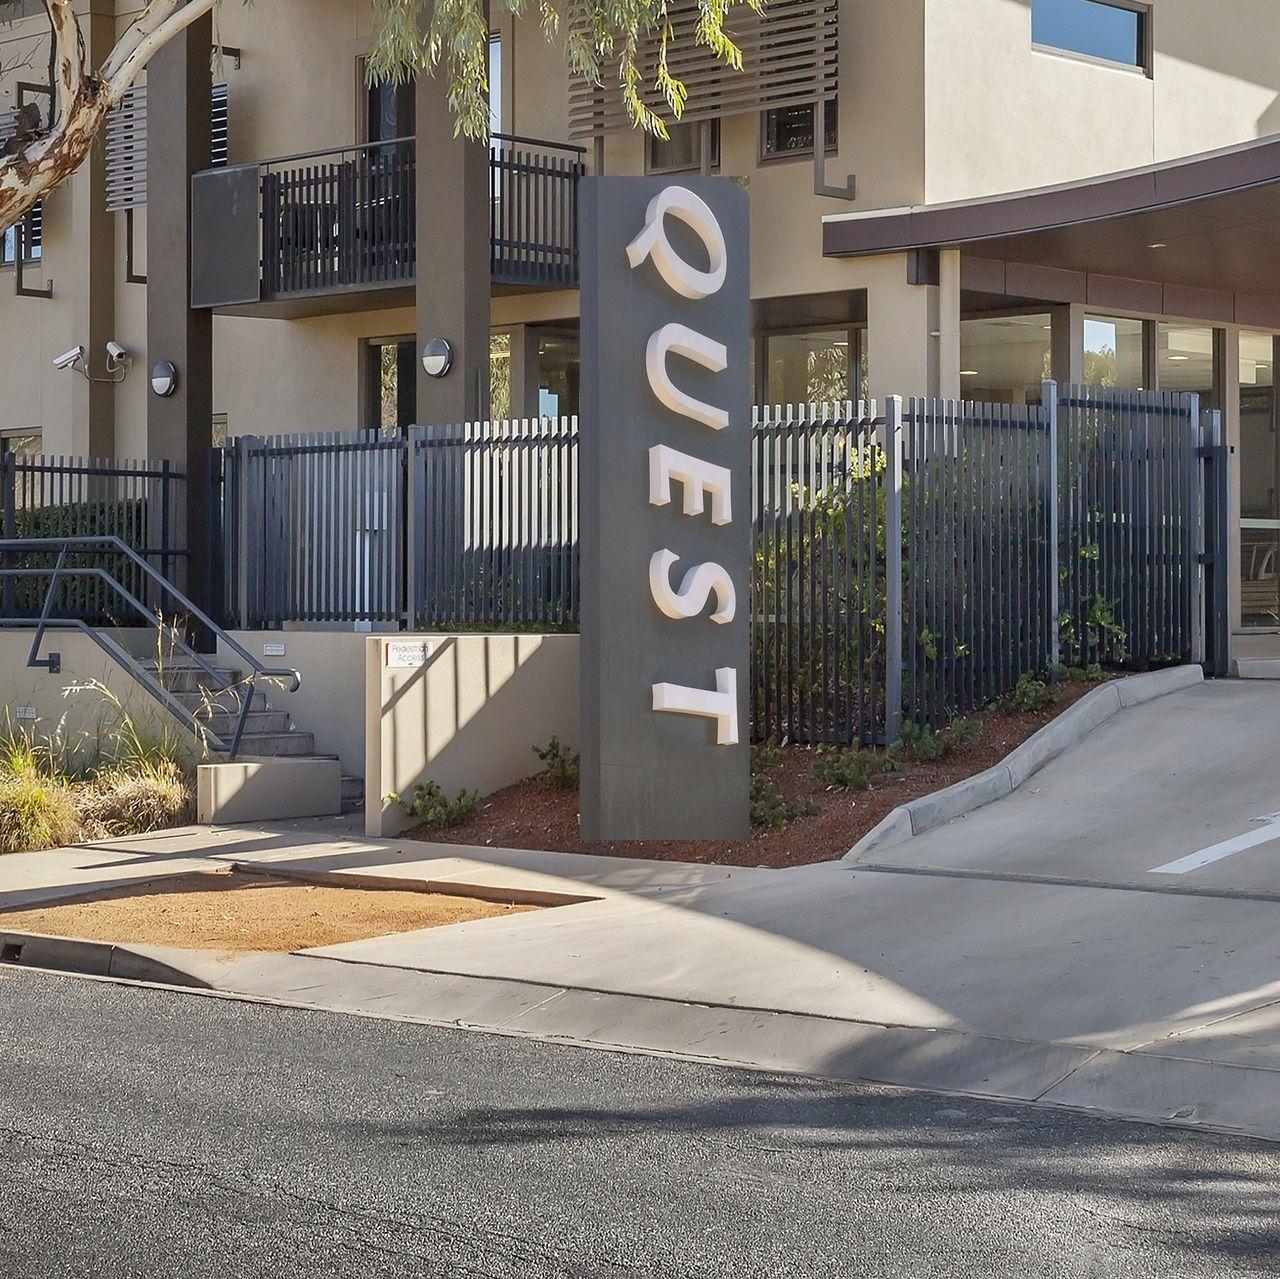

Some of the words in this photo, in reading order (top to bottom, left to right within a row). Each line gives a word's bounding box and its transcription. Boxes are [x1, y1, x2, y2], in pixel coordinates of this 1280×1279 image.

[627, 185, 740, 746] QUEST
[392, 644, 428, 653] Pedestrian
[397, 653, 426, 662] Access
